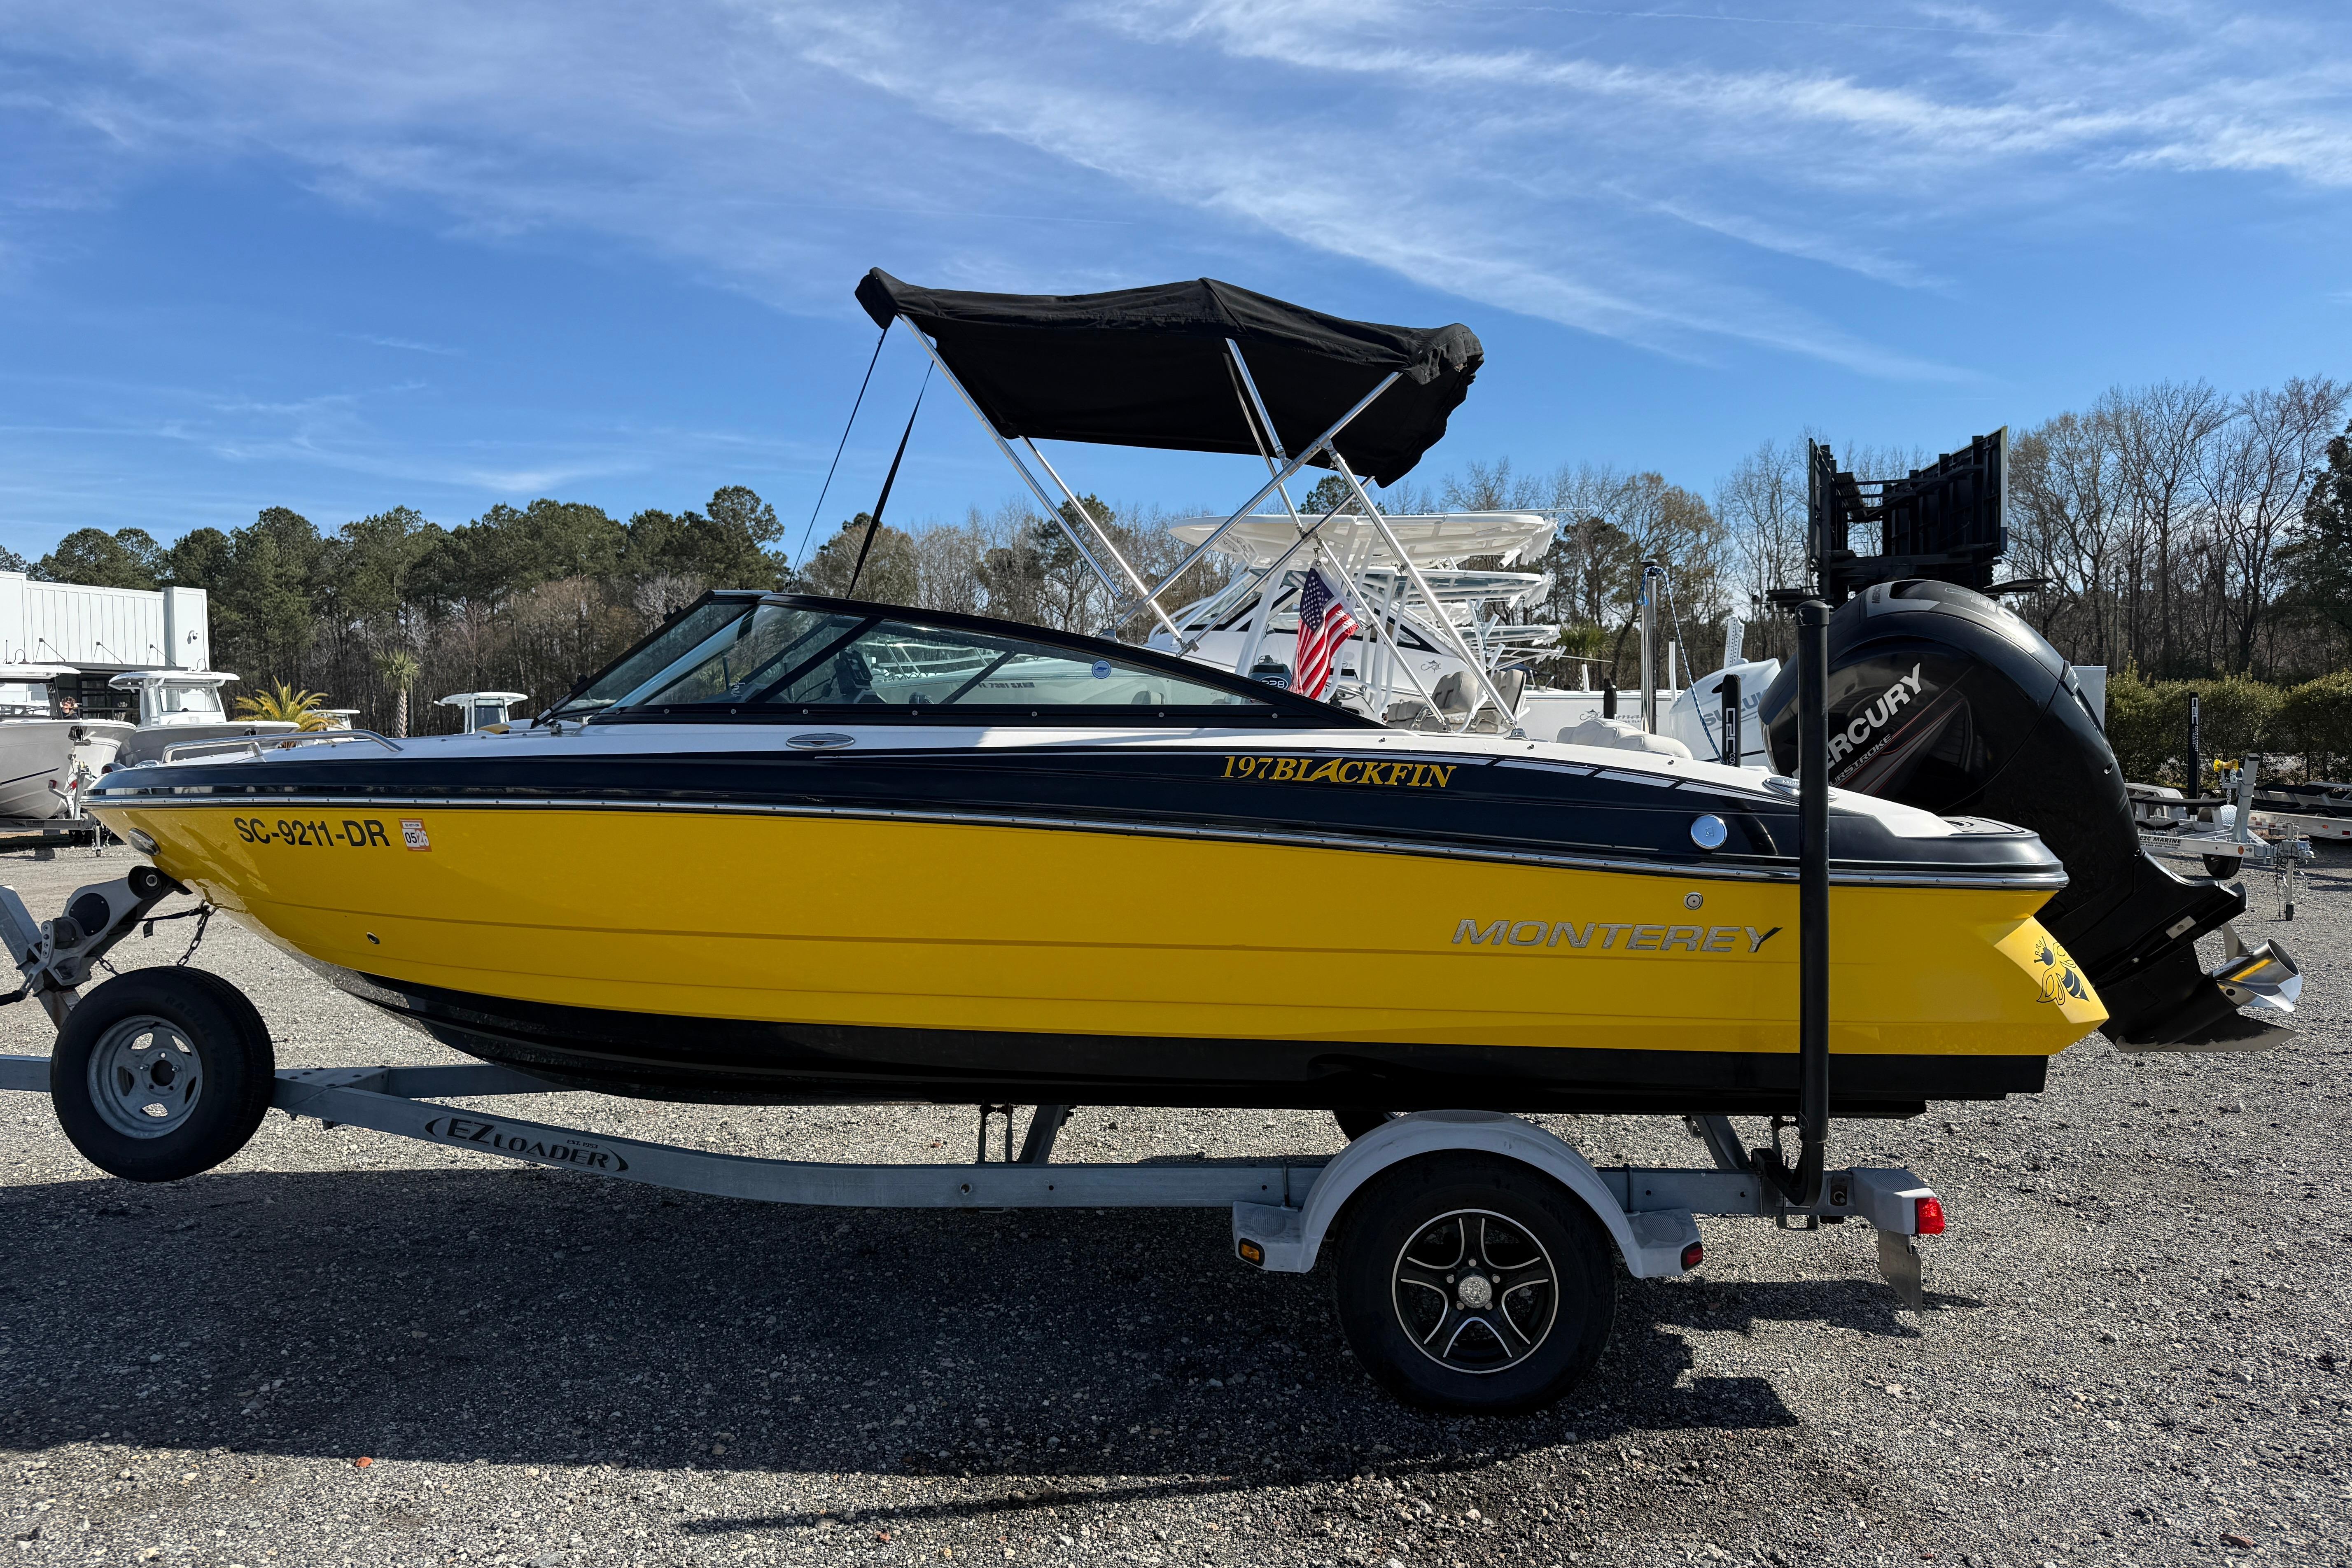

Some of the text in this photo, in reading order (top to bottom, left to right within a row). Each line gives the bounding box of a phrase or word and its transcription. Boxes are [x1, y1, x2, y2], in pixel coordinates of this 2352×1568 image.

[1792, 663, 1922, 779] RCURY
[234, 817, 391, 847] SC-9211-DR
[405, 830, 429, 847] 05 26
[1451, 919, 1783, 953] MONTEREY
